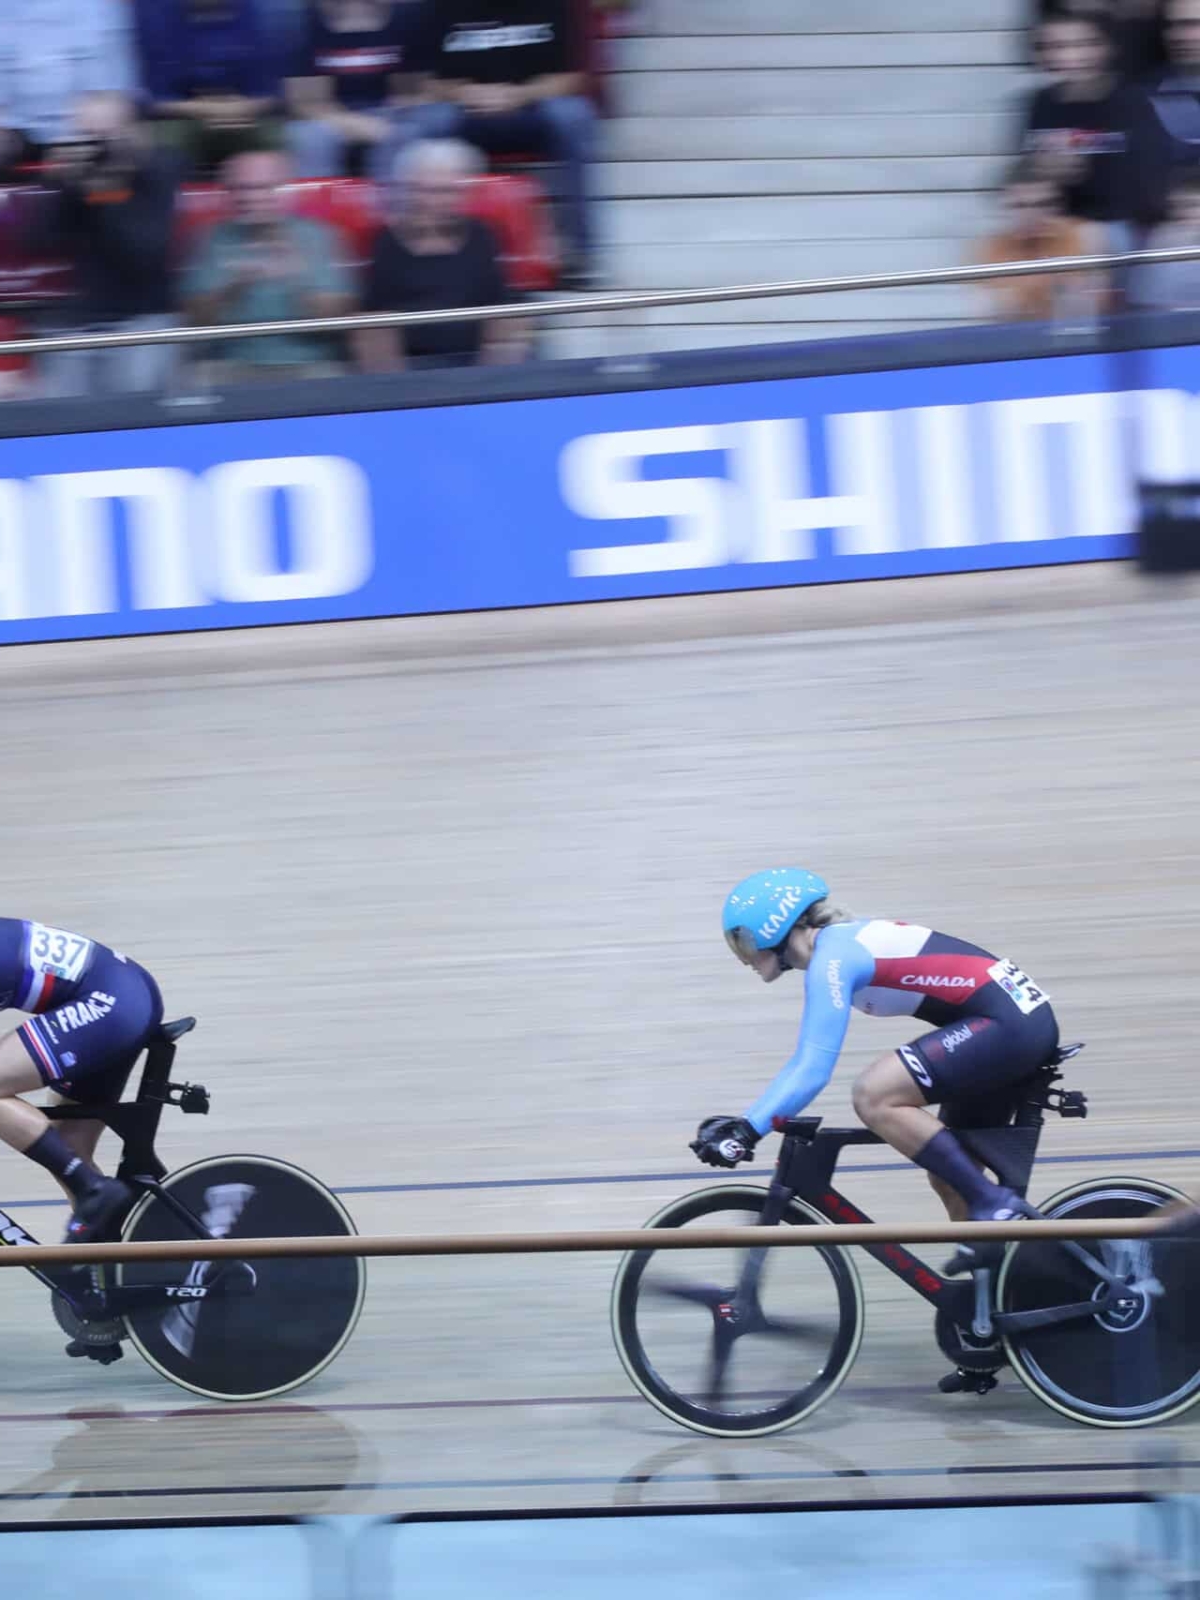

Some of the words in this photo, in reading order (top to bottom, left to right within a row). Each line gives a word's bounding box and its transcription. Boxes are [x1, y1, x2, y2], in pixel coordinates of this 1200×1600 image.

[758, 887, 801, 940] KASK
[33, 930, 88, 968] 337
[901, 974, 976, 988] CANADA
[1003, 960, 1043, 1002] 314
[56, 990, 117, 1033] FRANCE
[941, 1023, 974, 1053] global
[164, 1286, 210, 1298] T20
